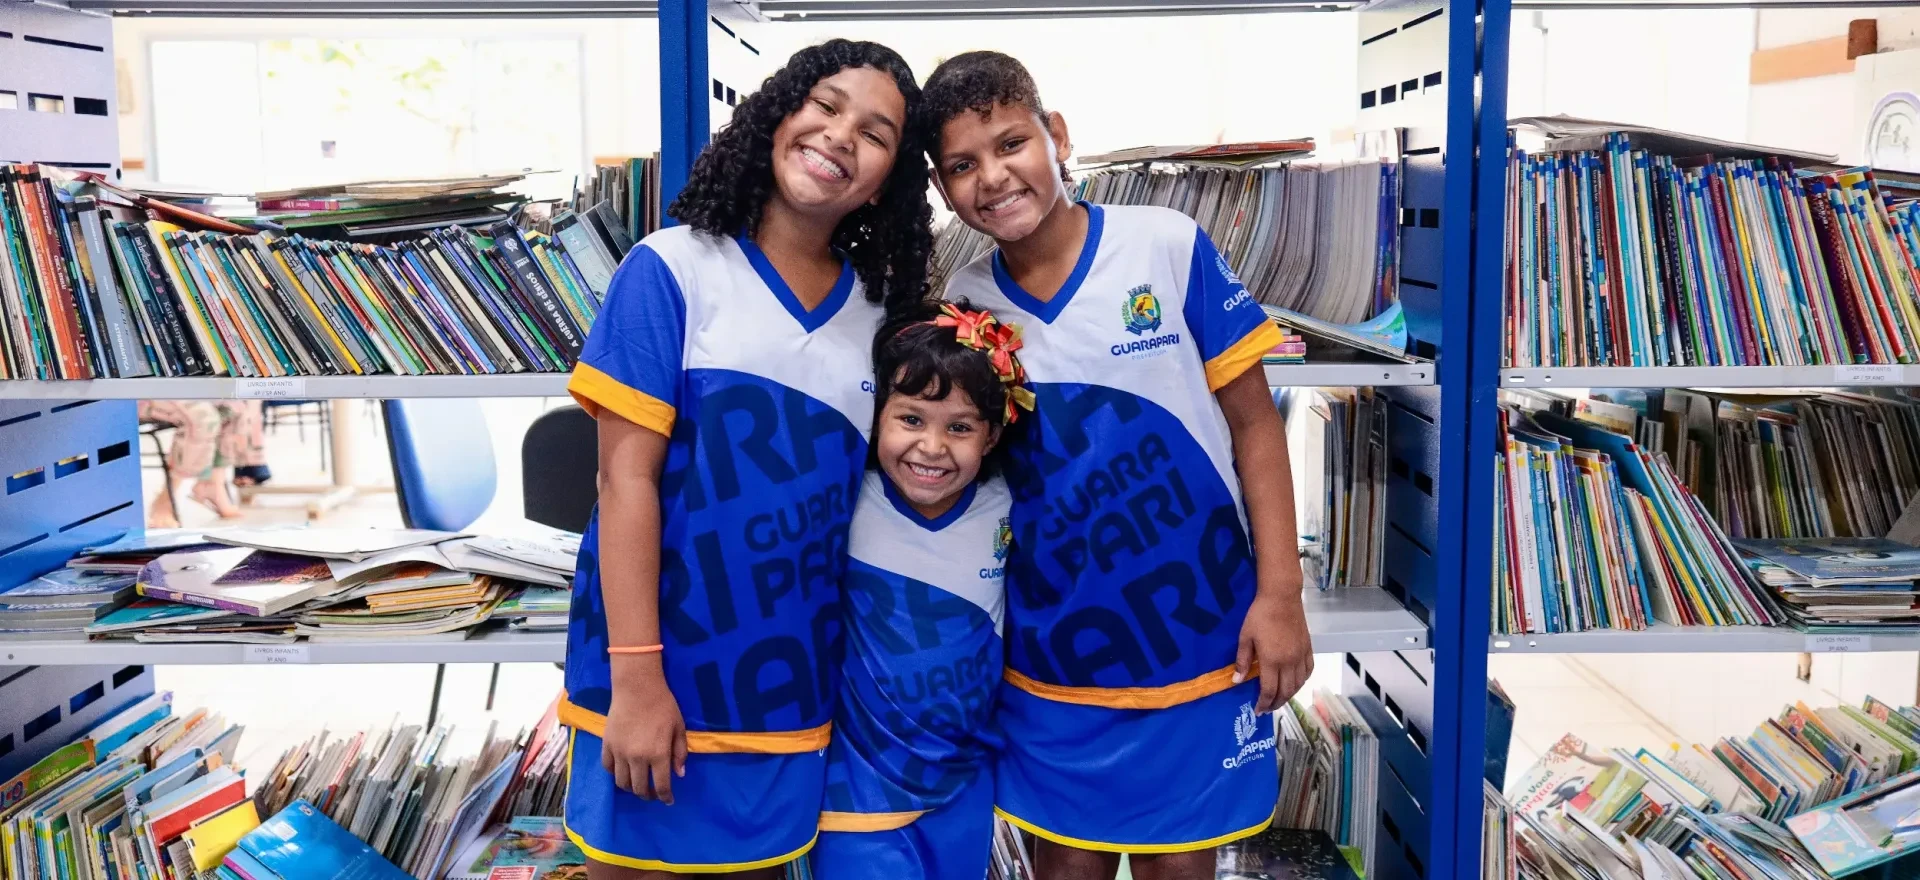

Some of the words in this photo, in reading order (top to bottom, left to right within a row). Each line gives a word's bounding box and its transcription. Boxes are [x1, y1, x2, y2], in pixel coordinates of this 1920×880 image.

[524, 270, 548, 301] GÊNIOS
[163, 300, 175, 319] Kate
[543, 298, 556, 312] DE
[550, 309, 574, 341] GUERRA
[112, 322, 131, 371] ASTRONÁUTICA
[569, 339, 579, 348] A
[1111, 334, 1180, 356] GUARAPARI
[1051, 466, 1197, 586] PARI
